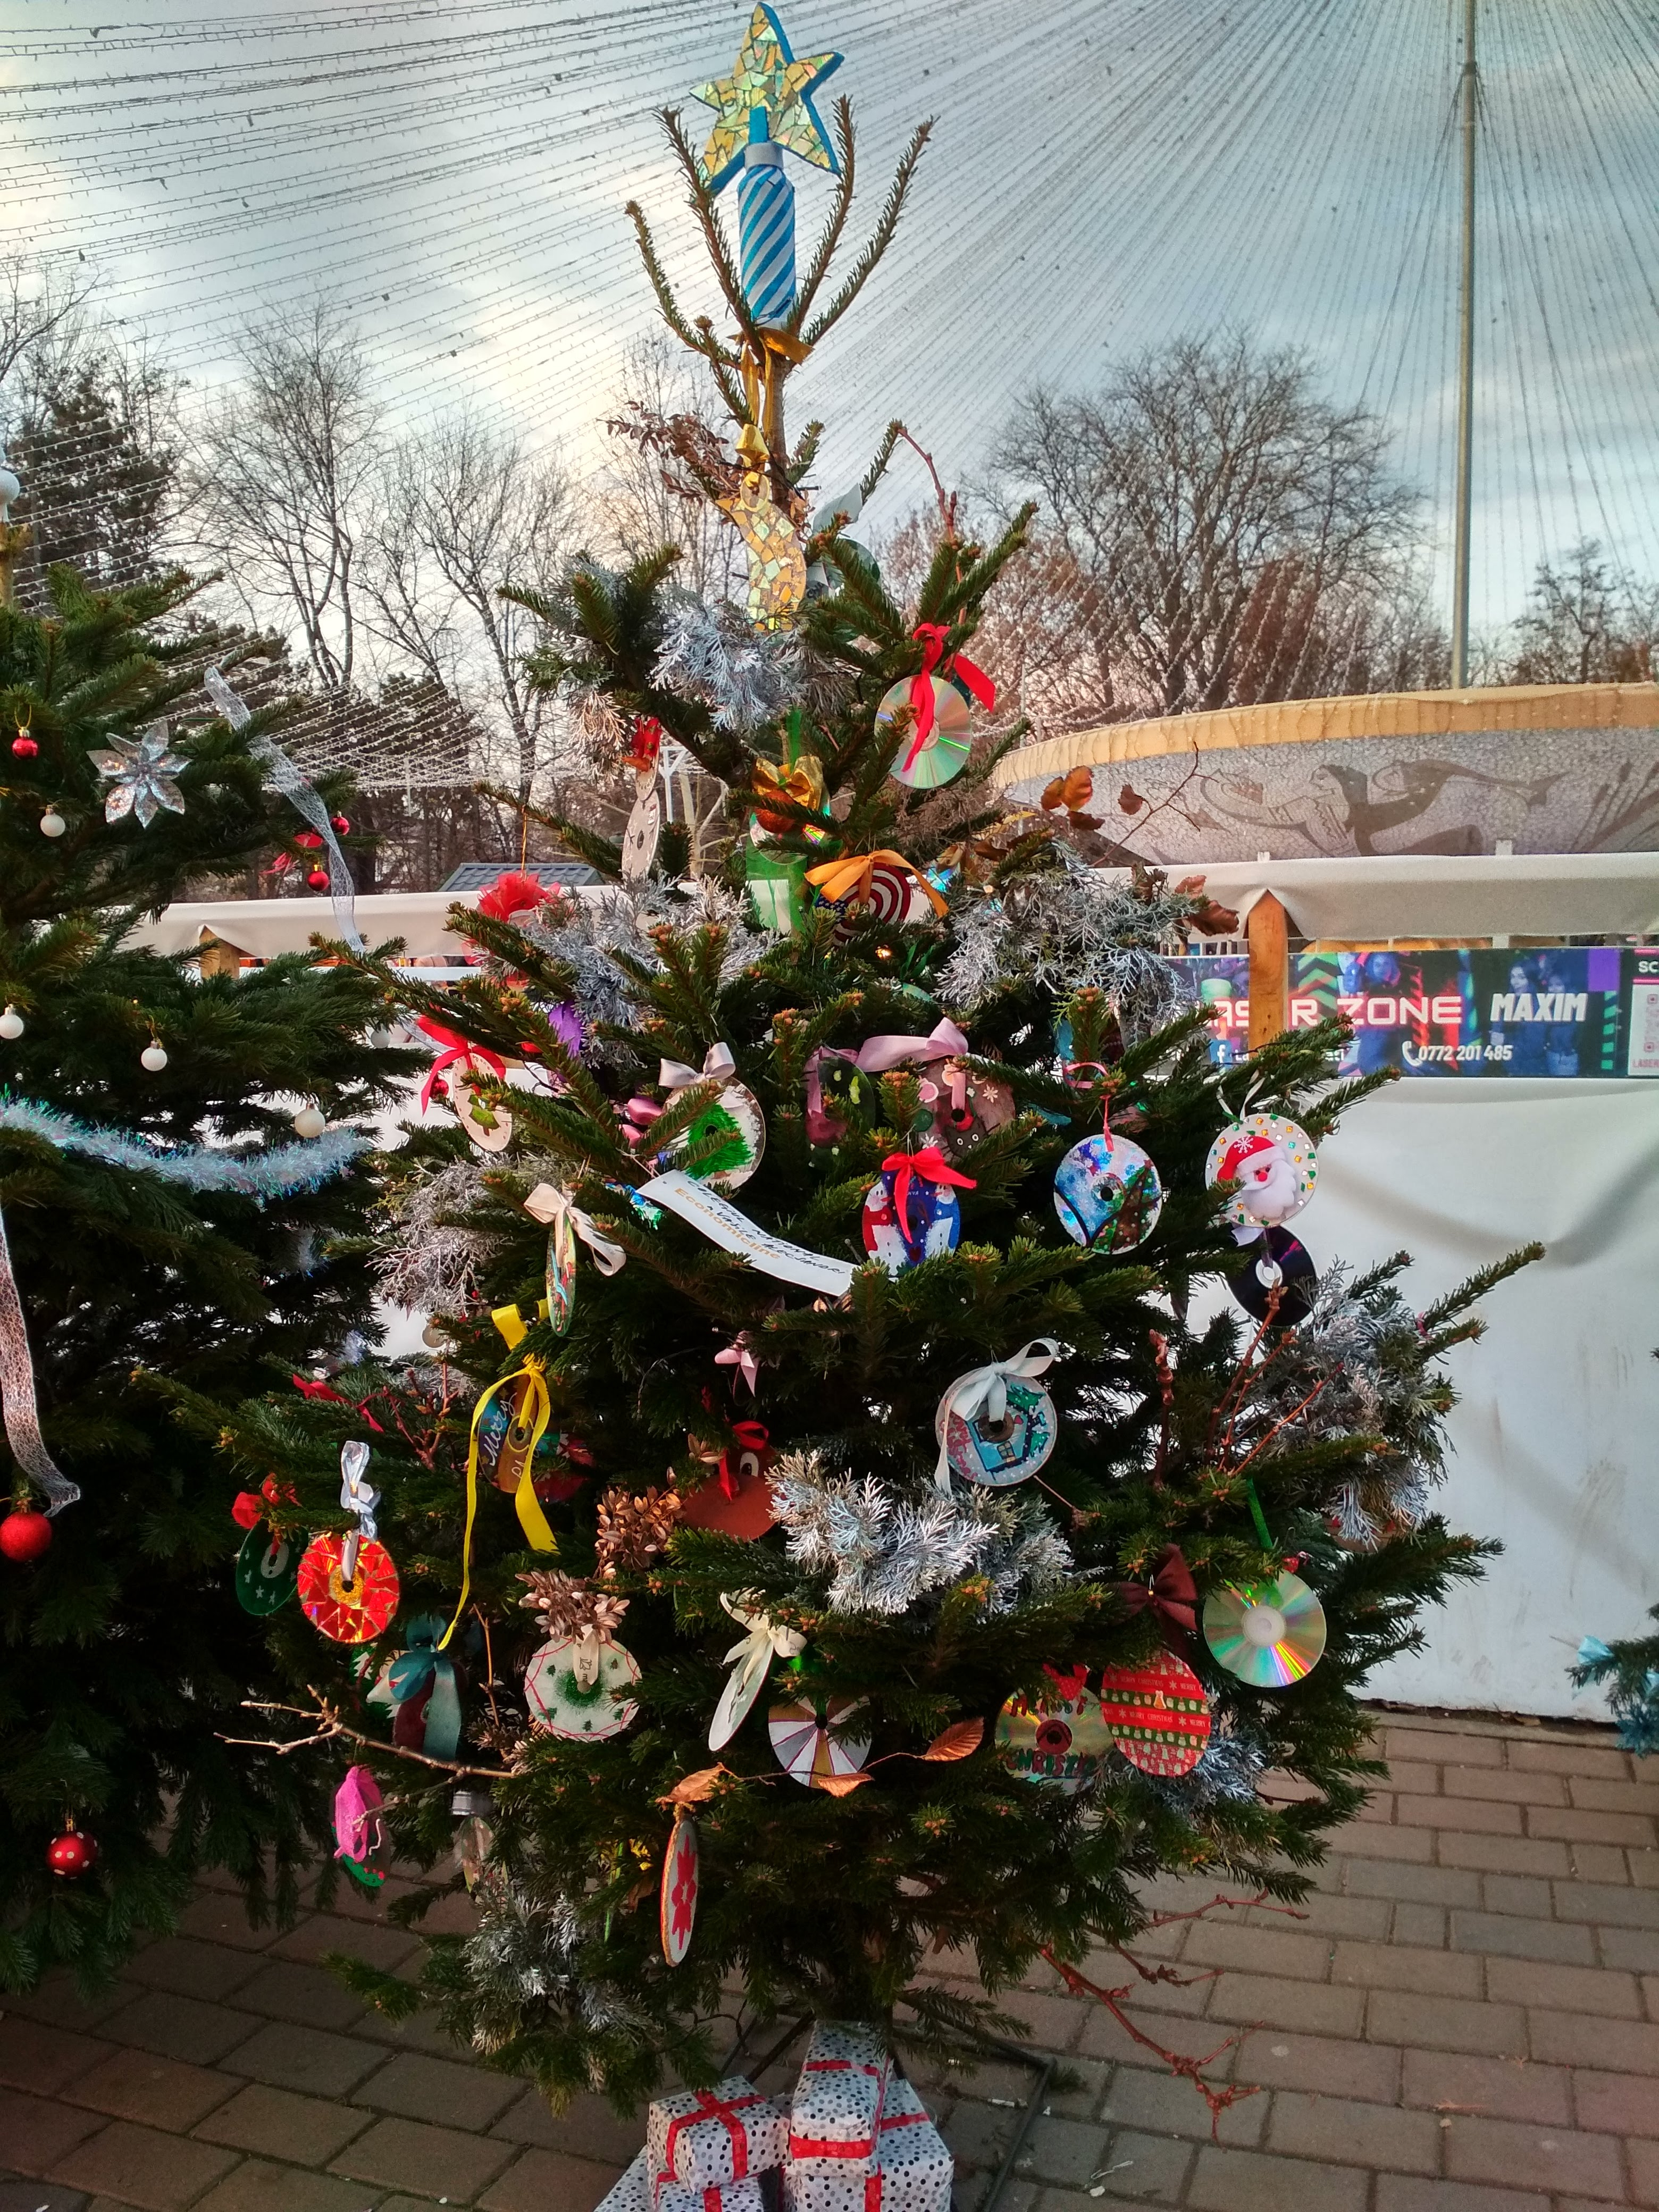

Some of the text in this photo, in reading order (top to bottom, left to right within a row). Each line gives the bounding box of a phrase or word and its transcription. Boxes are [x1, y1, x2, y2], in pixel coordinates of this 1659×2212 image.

[1337, 996, 1461, 1025] ZONE
[1490, 993, 1589, 1022] MAXIM
[1419, 1045, 1513, 1061] 0772 201 485
[674, 1188, 781, 1259] Economicline
[761, 1243, 845, 1274] ALECSANDRI
[484, 1392, 517, 1467] Merry
[1180, 1683, 1196, 1691] MERRY
[1147, 1713, 1173, 1723] CHRISTMAS
[1189, 1719, 1206, 1728] MERRY
